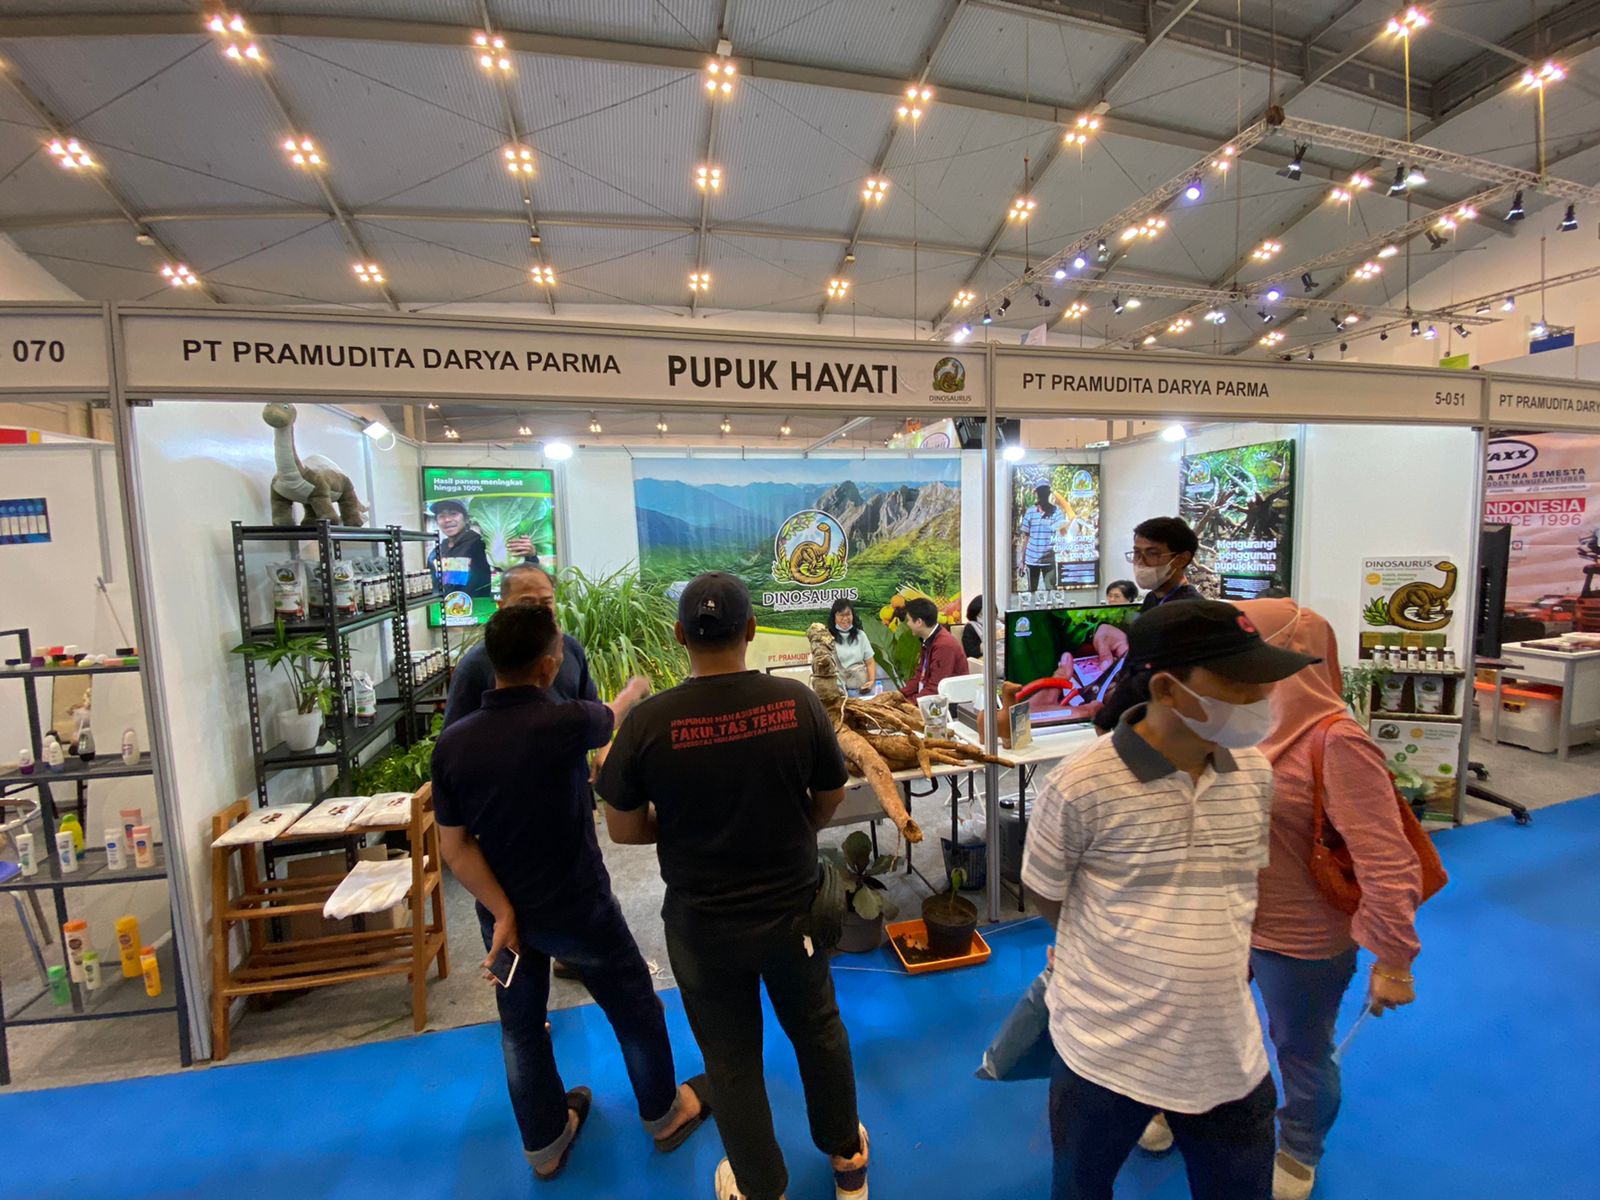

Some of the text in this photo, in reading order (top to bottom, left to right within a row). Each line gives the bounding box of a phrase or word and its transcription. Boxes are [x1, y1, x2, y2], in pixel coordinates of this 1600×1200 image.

[13, 340, 65, 362] 070
[182, 339, 621, 374] PT PRAMUDITA DARYA PARMA
[668, 355, 898, 394] PUPUK HAYATI
[1023, 373, 1269, 397] PT PRAMUDITA DARYA PARMA
[1435, 392, 1465, 406] 5-051
[1500, 394, 1513, 407] PT
[1516, 396, 1574, 411] PRAMUDITA
[1498, 472, 1528, 480] ATMA
[1532, 468, 1585, 478] SEMESTA
[1512, 476, 1585, 485] MANUFACTURER
[481, 478, 523, 487] meningkat
[1541, 514, 1581, 526] 1996
[1216, 538, 1276, 550] Mengurangi
[1215, 561, 1276, 572] pupuk kimia
[1365, 560, 1433, 568] DINOSAURUS
[763, 587, 858, 605] DINOSAURUS
[671, 709, 797, 742] FAKULTAS TEKNIK
